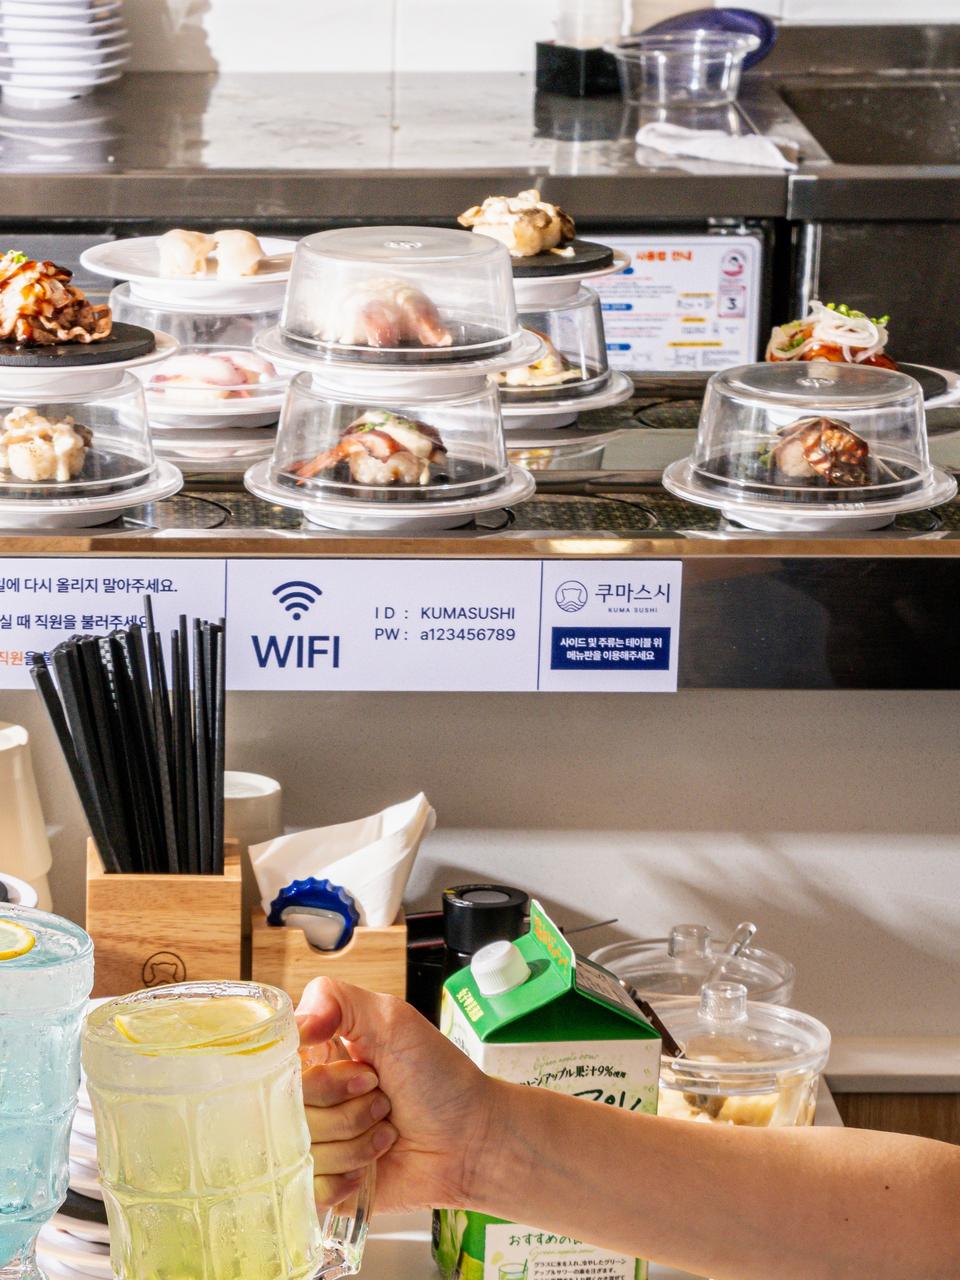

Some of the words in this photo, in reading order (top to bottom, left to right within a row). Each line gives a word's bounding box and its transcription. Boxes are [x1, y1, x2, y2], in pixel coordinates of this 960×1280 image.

[727, 297, 737, 310] 3
[24, 577, 52, 594] 다시
[56, 577, 99, 594] 올리지
[103, 577, 178, 594] 말아주세요.
[595, 583, 671, 604] 쿠마스시
[421, 608, 516, 620] KUMASUSHI
[17, 613, 30, 630] 때
[35, 613, 77, 630] 직원을
[421, 629, 515, 641] a123456789
[560, 637, 587, 648] 사이드
[588, 637, 597, 648] 및
[598, 637, 625, 648] 주류는
[625, 637, 652, 648] 테이블
[653, 637, 663, 648] 위
[251, 635, 340, 669] WIFI
[566, 650, 601, 661] 메뉴판을
[603, 650, 656, 661] 이용해주세요
